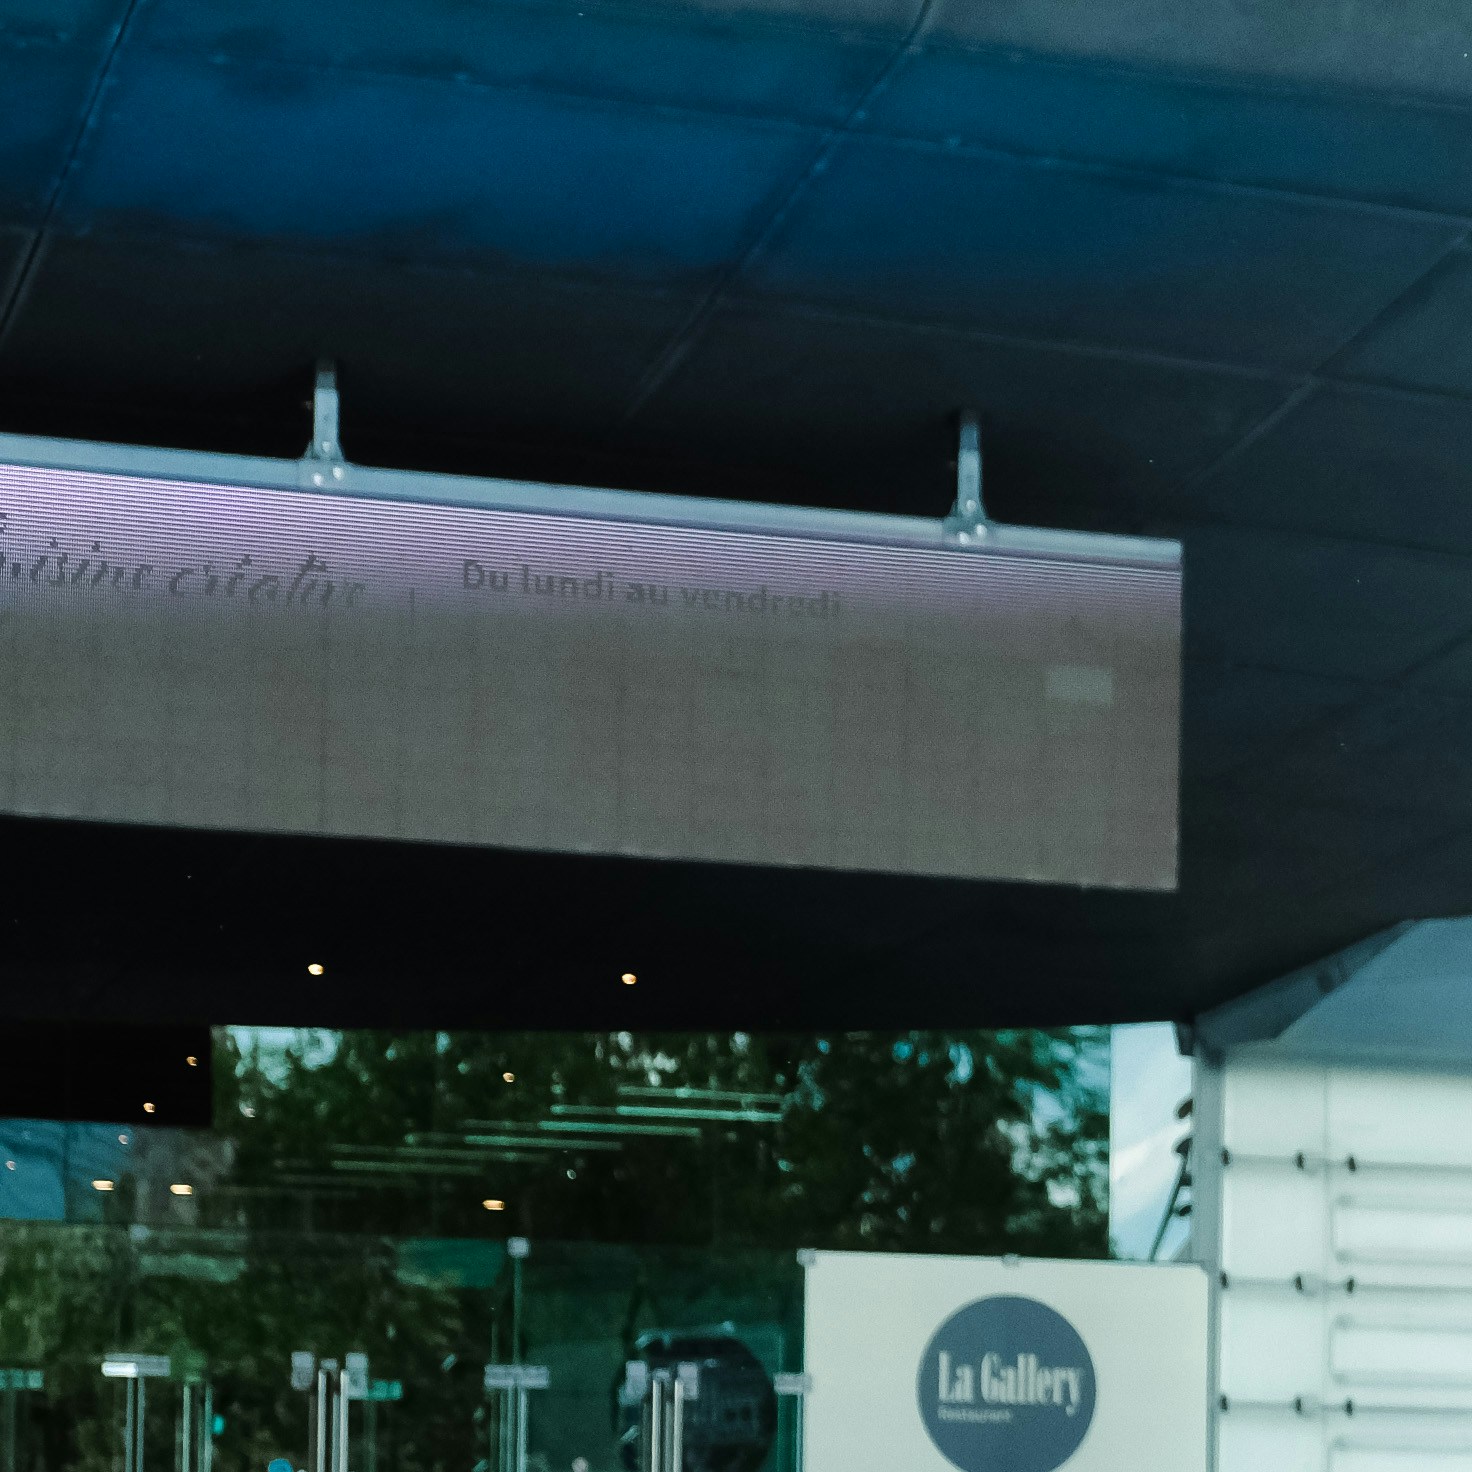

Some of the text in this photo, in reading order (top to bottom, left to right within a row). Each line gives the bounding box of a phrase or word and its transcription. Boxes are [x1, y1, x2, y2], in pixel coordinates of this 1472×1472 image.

[461, 559, 508, 592] Du
[521, 563, 615, 600] lundi
[626, 583, 667, 604] au
[938, 1350, 1082, 1418] La Gallery
